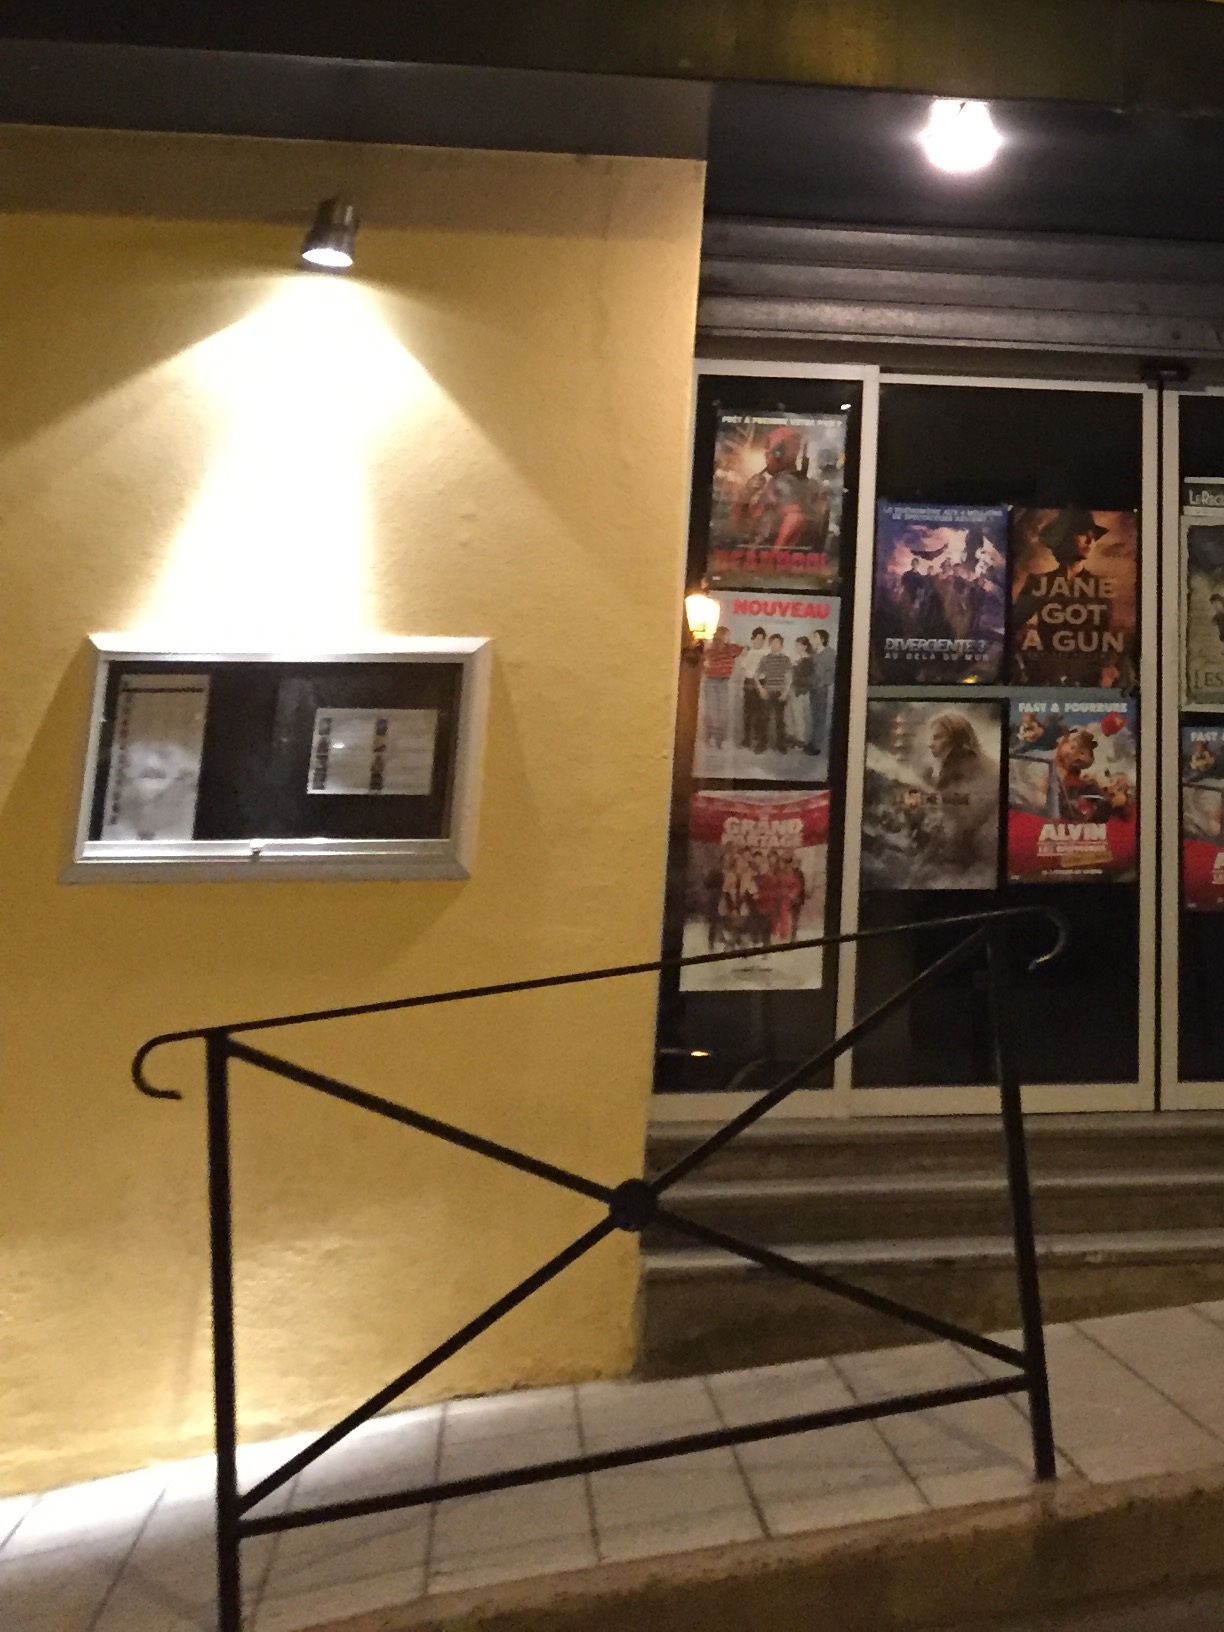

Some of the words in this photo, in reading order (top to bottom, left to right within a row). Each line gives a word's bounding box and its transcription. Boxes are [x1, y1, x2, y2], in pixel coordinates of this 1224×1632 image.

[1031, 575, 1119, 599] JANE
[733, 598, 831, 620] NOUVEAU
[1041, 602, 1108, 626] GOT
[885, 637, 974, 652] DIVERGENTE
[1020, 629, 1045, 651] A
[1052, 630, 1125, 653] GUN
[1193, 669, 1224, 689] LES
[722, 816, 804, 833] GRAND
[1038, 823, 1108, 841] ALVIN
